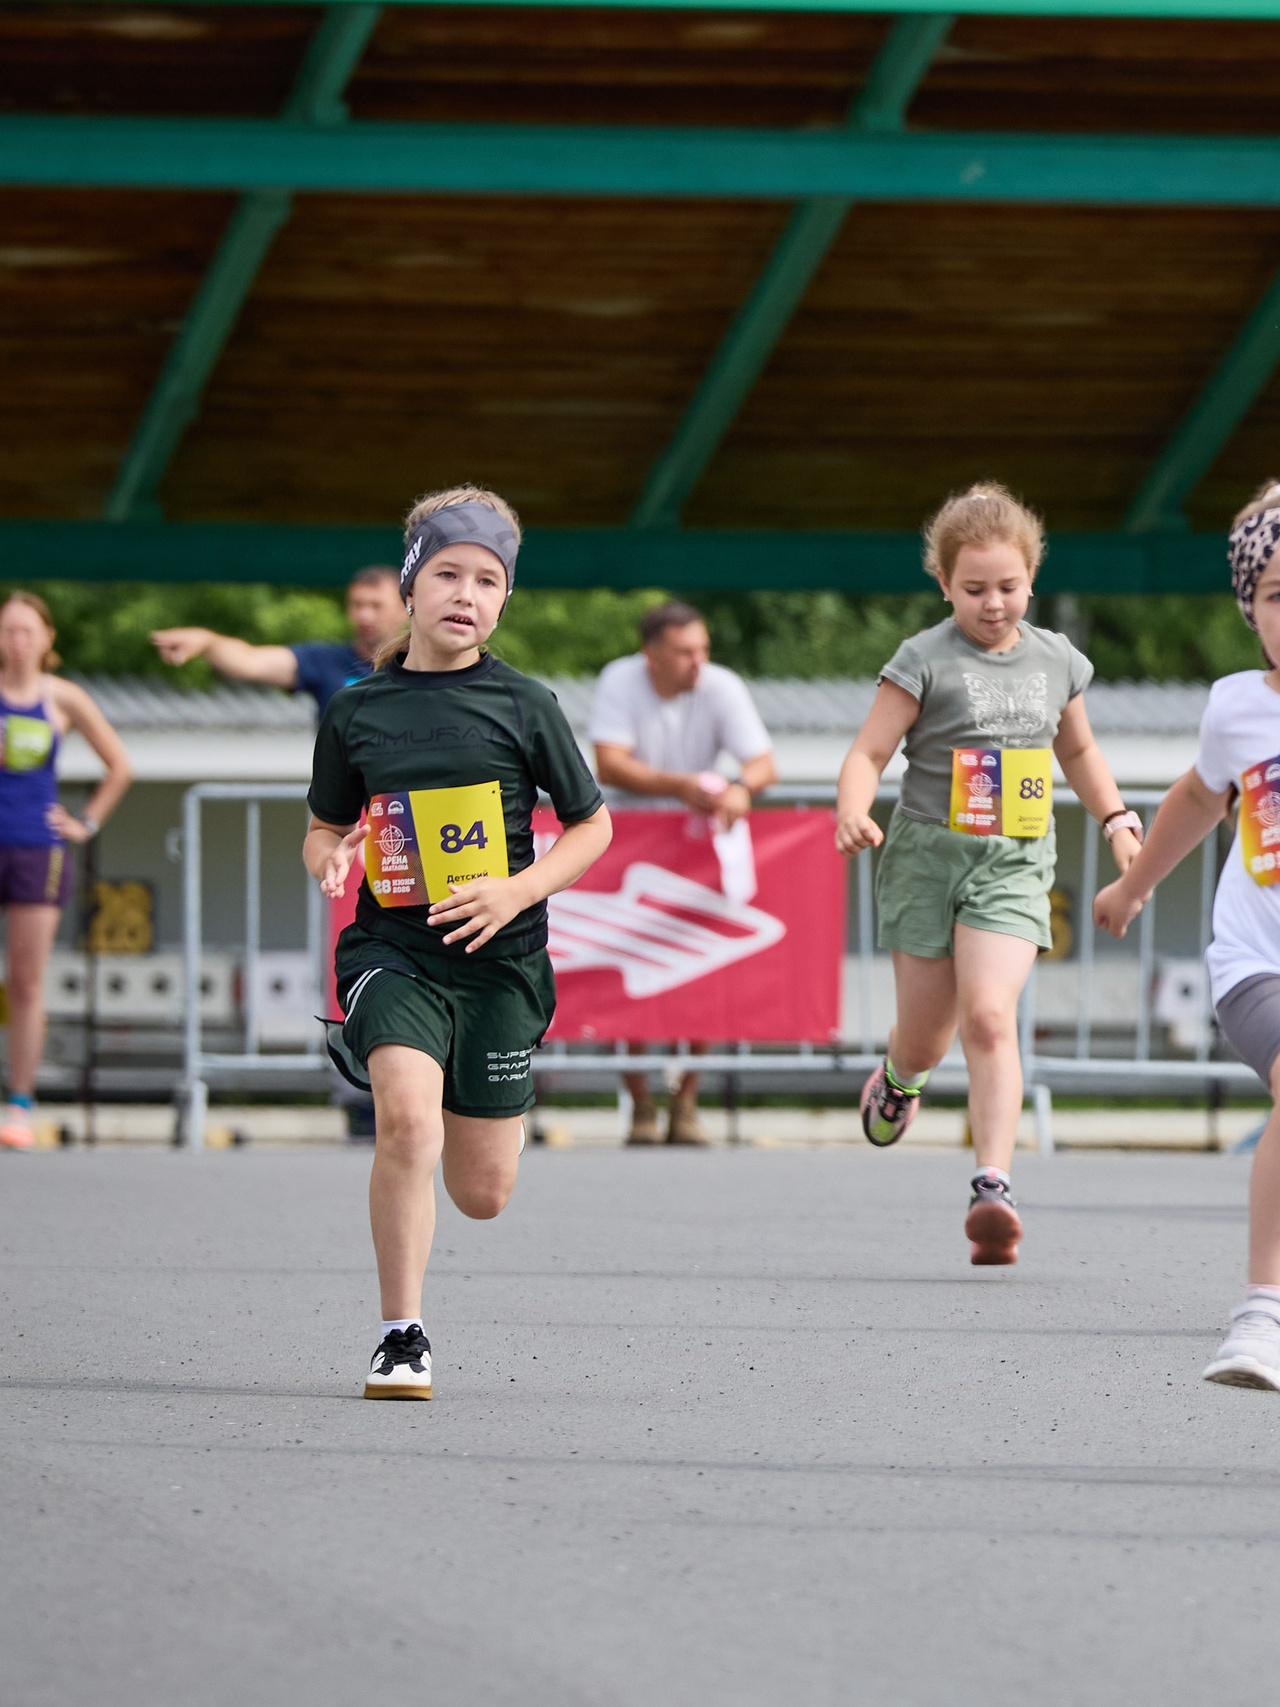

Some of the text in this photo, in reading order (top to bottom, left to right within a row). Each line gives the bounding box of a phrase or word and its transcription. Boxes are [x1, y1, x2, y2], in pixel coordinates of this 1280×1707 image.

[1019, 777, 1044, 800] 88
[439, 820, 488, 854] 84
[381, 855, 408, 866] АРЕНА
[446, 869, 488, 884] Детский
[372, 879, 392, 895] 28
